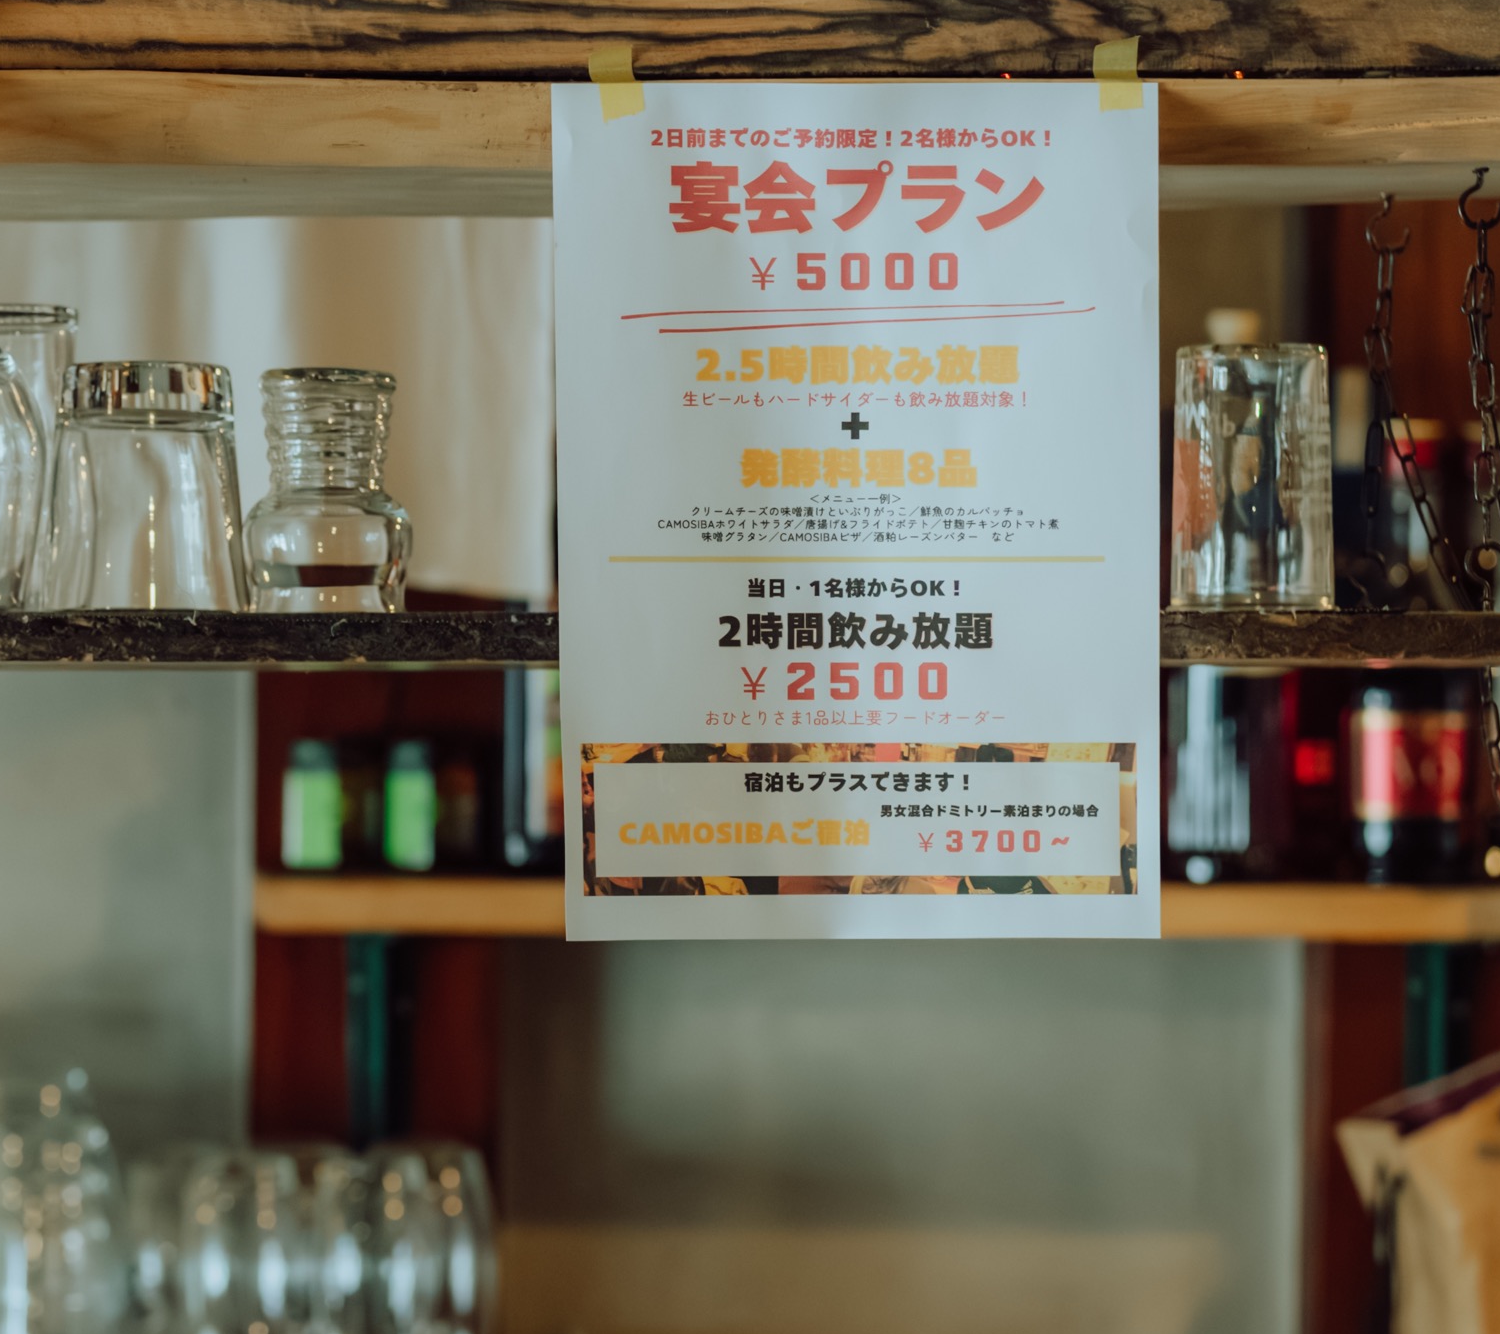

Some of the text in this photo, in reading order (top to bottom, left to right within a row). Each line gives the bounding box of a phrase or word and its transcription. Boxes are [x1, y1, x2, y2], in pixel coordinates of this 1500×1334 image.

[651, 128, 1050, 148] 2日前までのご予約限定！2名様からOK！
[669, 160, 1044, 234] 宴会プラン
[695, 344, 1018, 385] 2.5時間飲み放題
[682, 391, 1025, 408] 生ビールもハードサイダーも飲み放題対象！
[739, 447, 976, 488] 発酵料理8品
[748, 578, 959, 598] 当日・1名様からOK！
[719, 612, 992, 650] 2時間飲み放題
[705, 710, 1003, 726] おひとりさま1品以上要フードオーダー
[744, 772, 968, 792] 宿泊もプラスできます！
[881, 805, 1099, 817] 男女混合ドミトリー素泊まりの場合
[619, 819, 870, 846] CAMOSIBAご宿泊
